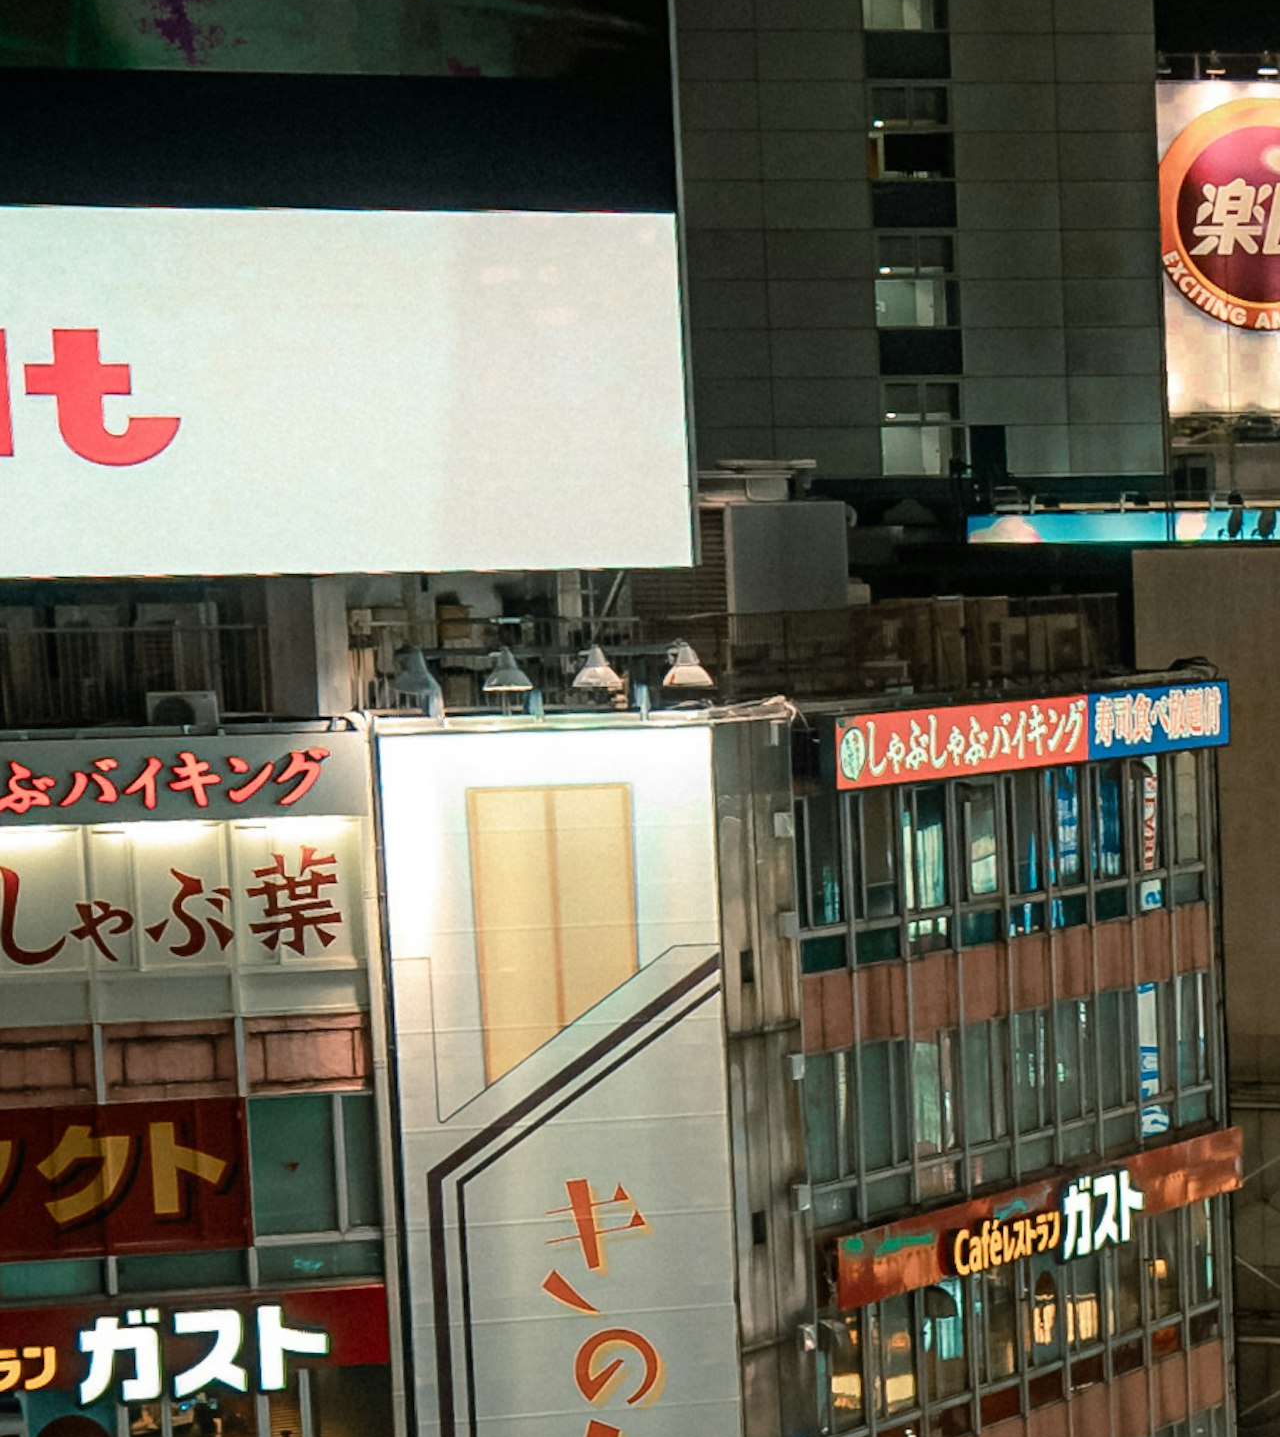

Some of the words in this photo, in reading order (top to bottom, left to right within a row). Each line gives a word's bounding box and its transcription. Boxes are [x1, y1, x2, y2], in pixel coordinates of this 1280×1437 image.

[1162, 251, 1248, 328] EXCITING
[0, 746, 330, 814] ぶバイキング
[865, 705, 1086, 776] しゃぶしゃぶバイキング
[0, 847, 341, 962] しゃぶ葉
[0, 1122, 226, 1225] クト
[954, 1220, 1001, 1276] Café
[1062, 1170, 1146, 1258] ガスト
[80, 1305, 330, 1405] ガスト
